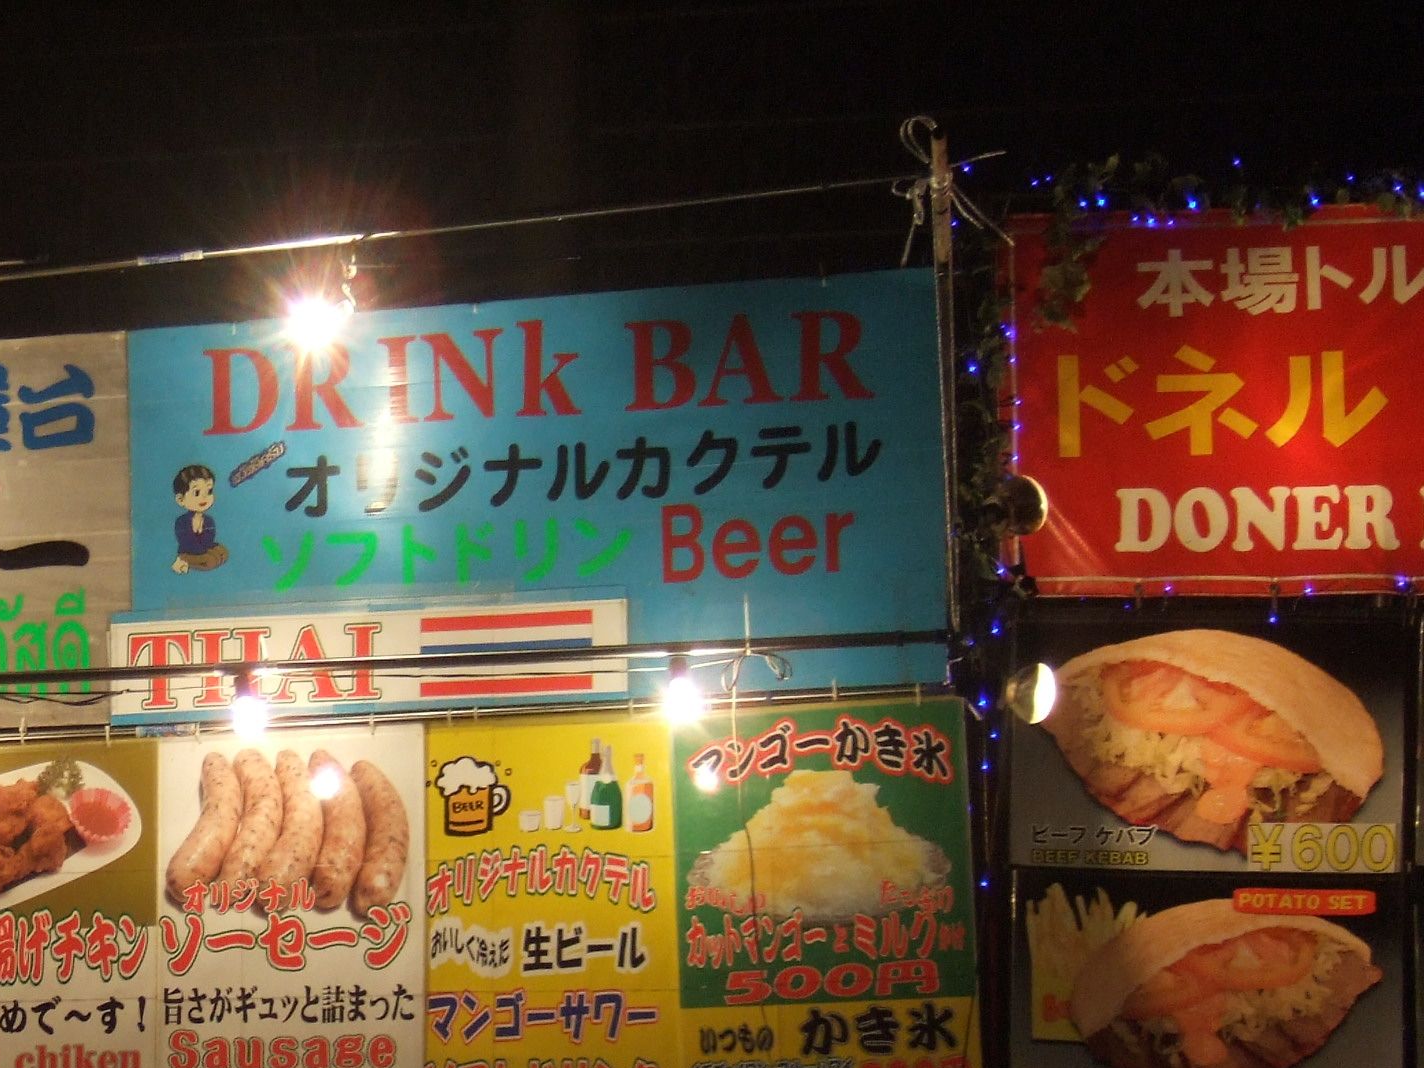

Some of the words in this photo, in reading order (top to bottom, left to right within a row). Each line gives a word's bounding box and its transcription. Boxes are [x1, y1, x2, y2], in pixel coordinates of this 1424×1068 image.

[624, 309, 876, 413] BAR
[1057, 344, 1389, 458] ドネル
[284, 421, 883, 517] オリジナルカクテル
[660, 503, 856, 584] Beer
[1115, 484, 1400, 553] DONER
[260, 517, 633, 592] ソフトドリン
[128, 623, 382, 710] THAI
[452, 801, 484, 813] BEER
[1085, 850, 1149, 866] KEBAB
[1249, 824, 1396, 873] ¥600
[182, 876, 316, 914] オリジナル
[427, 843, 656, 917] オリジナルカクテル
[1238, 893, 1320, 910] POTATO
[1328, 895, 1367, 911] SET
[159, 896, 411, 976] ソーセージ
[523, 926, 646, 971] 生ビール
[725, 958, 940, 1005] 500円
[427, 988, 658, 1044] マンゴーサワー
[801, 1002, 958, 1056] かき氷
